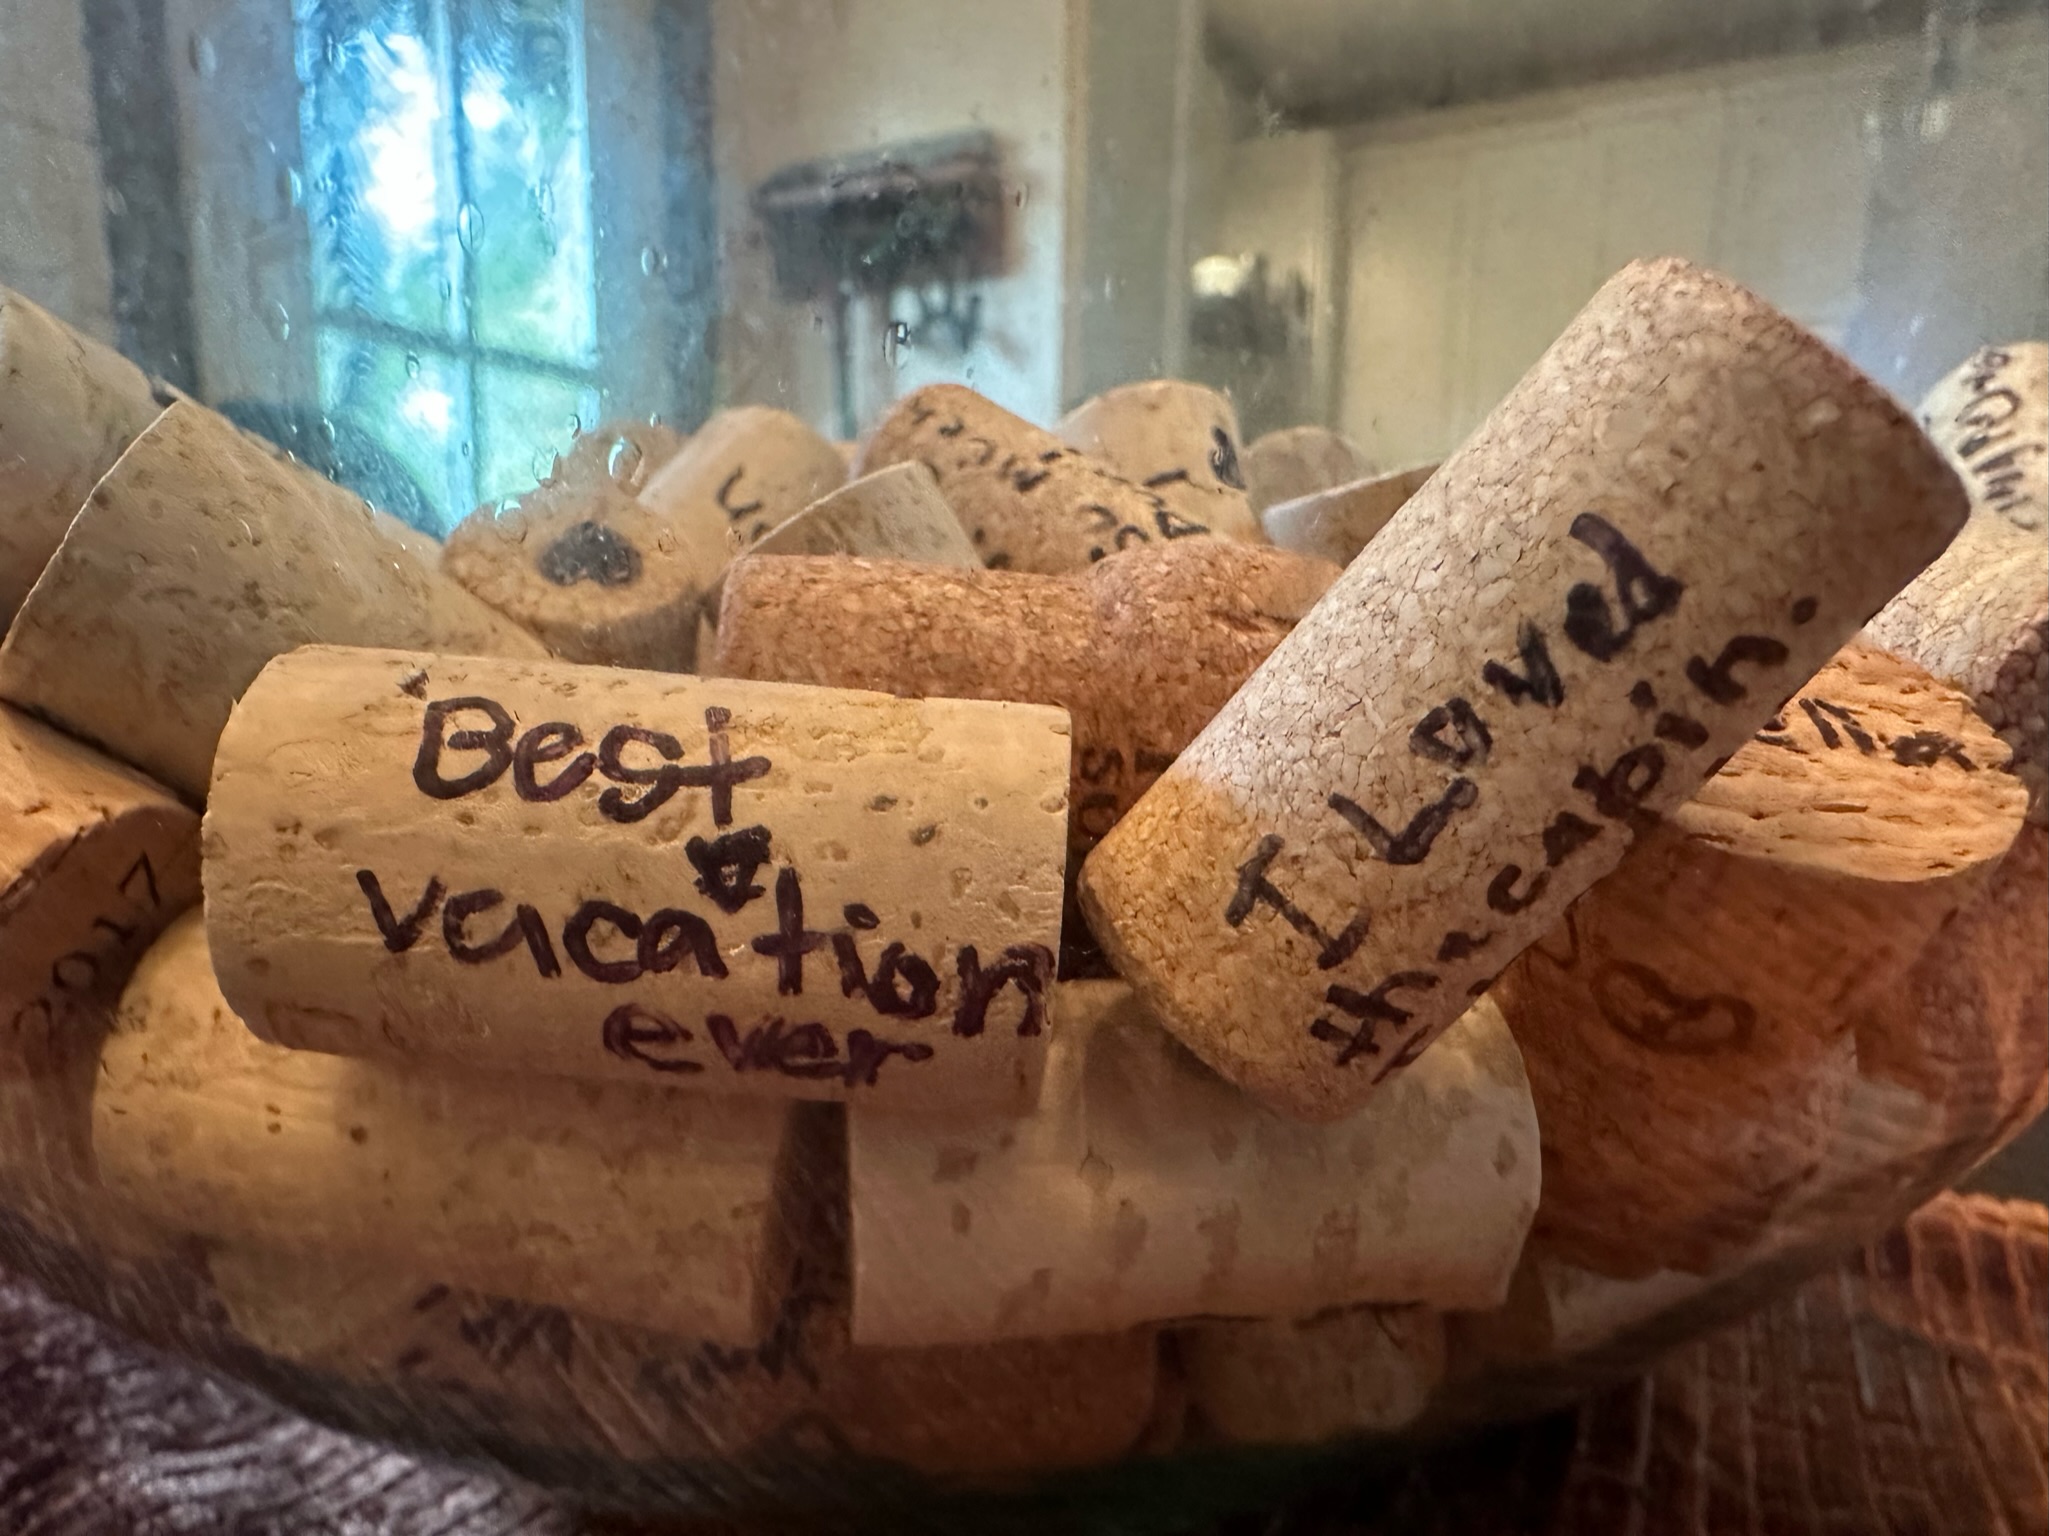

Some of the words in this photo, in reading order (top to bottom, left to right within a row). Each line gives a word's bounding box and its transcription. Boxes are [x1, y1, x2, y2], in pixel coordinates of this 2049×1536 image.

[412, 695, 772, 827] Best
[1225, 832, 1372, 971] I
[602, 1002, 935, 1088] ever
